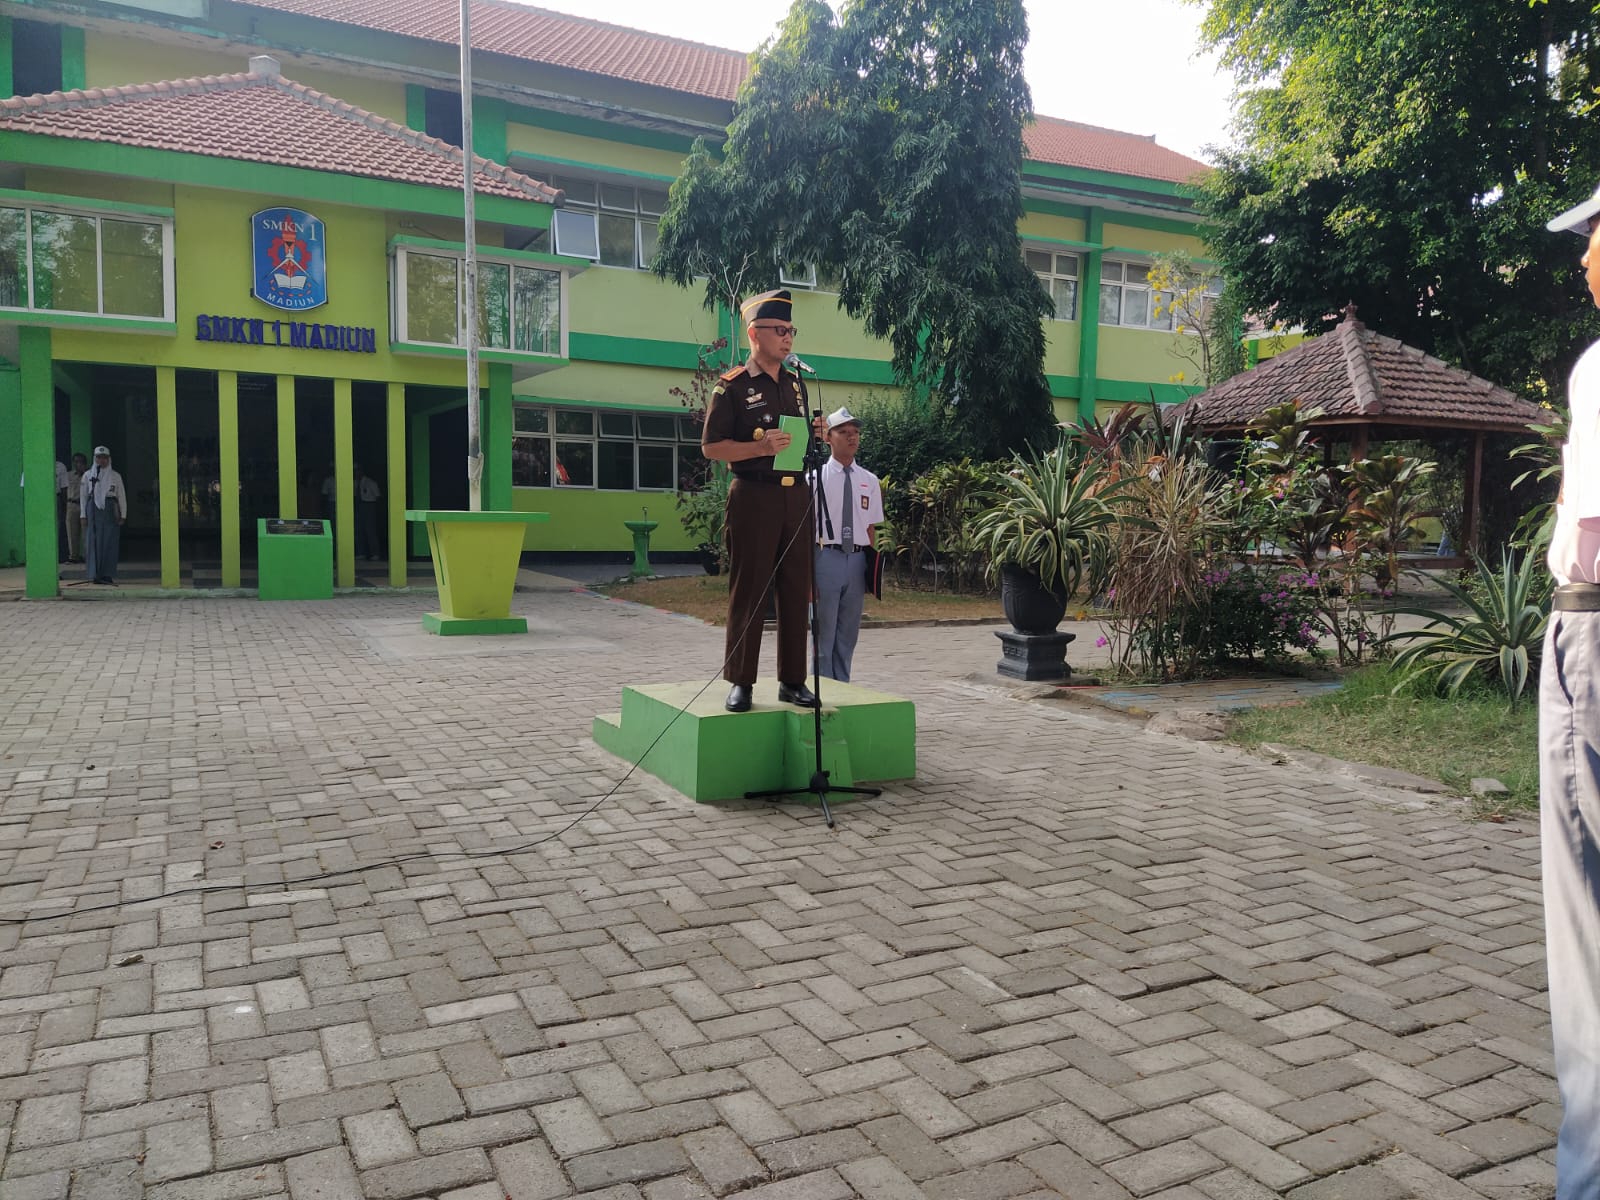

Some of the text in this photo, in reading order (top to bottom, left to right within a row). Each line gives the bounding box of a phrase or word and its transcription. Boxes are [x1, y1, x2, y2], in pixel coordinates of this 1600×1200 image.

[262, 219, 317, 241] SMKN 1
[266, 292, 315, 307] MADIUN
[197, 313, 376, 353] SMKN 1 MADIUN
